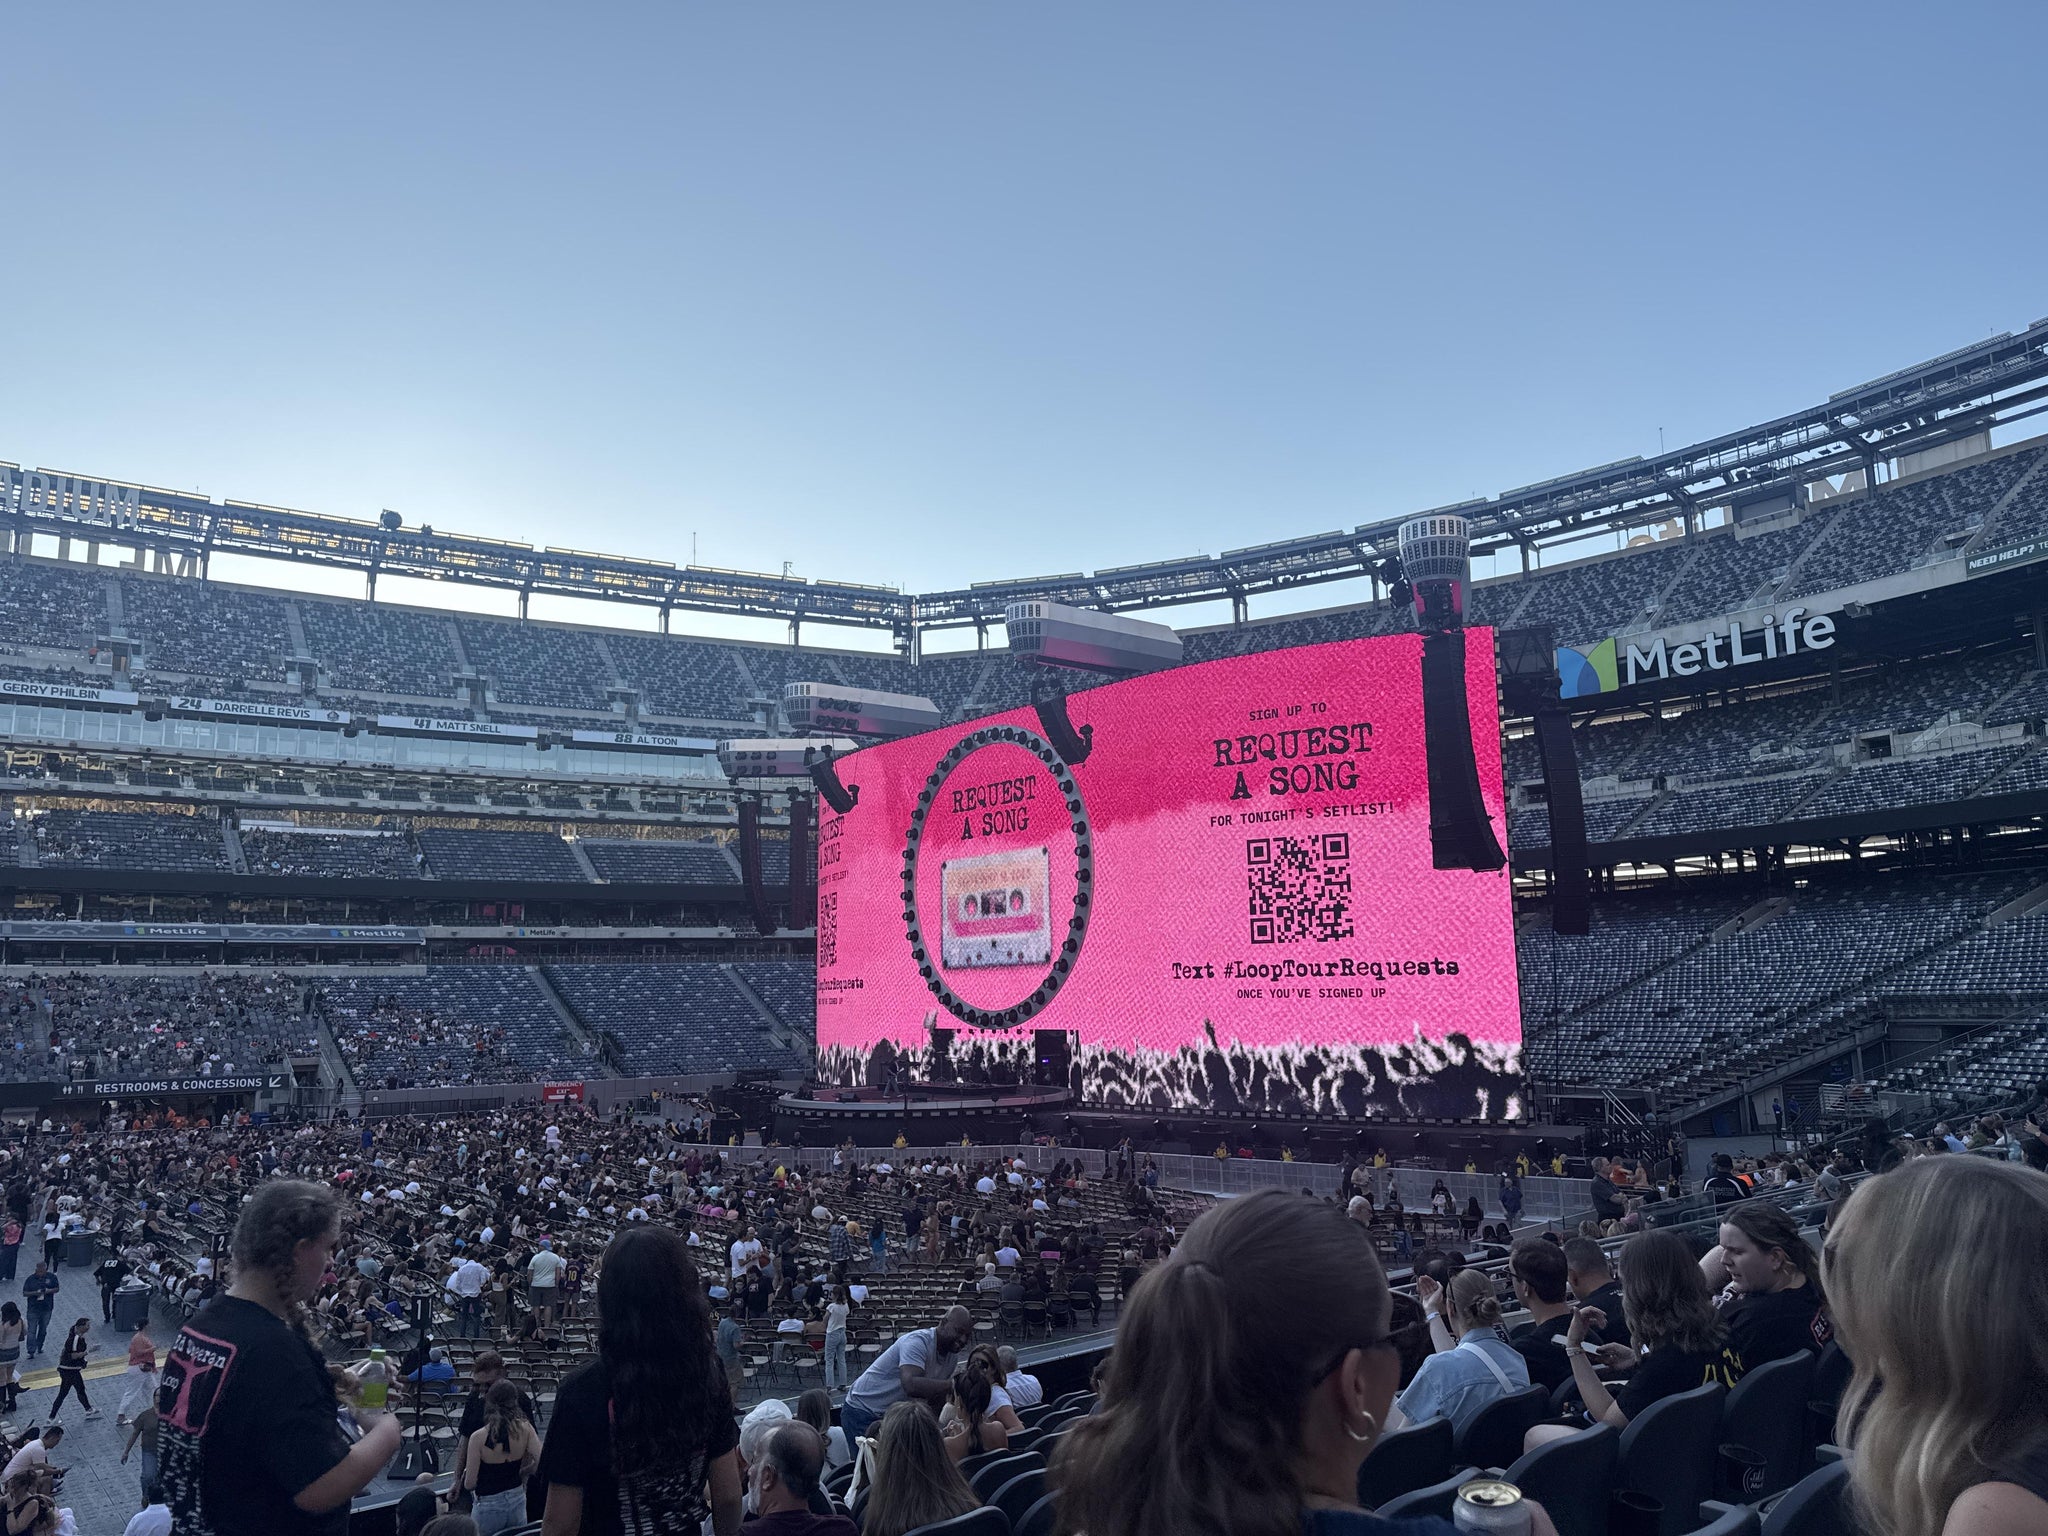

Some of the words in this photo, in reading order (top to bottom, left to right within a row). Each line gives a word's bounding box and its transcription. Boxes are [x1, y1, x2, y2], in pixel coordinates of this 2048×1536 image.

[1969, 554, 1997, 569] NEED
[1999, 544, 2035, 561] HELP?
[1626, 607, 1836, 685] MetLife
[2, 682, 48, 696] GERRY
[50, 687, 100, 700] PHILBIN
[177, 697, 202, 710] 24
[214, 702, 275, 716] DARRELLE
[276, 707, 311, 719] REVIS
[1249, 709, 1279, 721] SIGN
[1287, 706, 1302, 717] UP
[1311, 703, 1327, 714] TO
[414, 718, 432, 729] 41
[436, 721, 468, 732] MATT
[469, 723, 502, 734] SNELL
[614, 733, 633, 744] 88
[636, 735, 651, 745] AL
[652, 736, 678, 746] TOON
[1213, 723, 1373, 767] REQUEST
[1230, 771, 1252, 800] A
[1269, 761, 1360, 796] SONG
[952, 775, 1036, 813] REQUEST
[1210, 815, 1232, 827] FOR
[1240, 808, 1314, 824] TONIGHT'S
[1323, 802, 1394, 818] SETLIST!
[961, 817, 973, 840] A
[982, 809, 1030, 837] SONG
[149, 927, 207, 936] MetLife
[353, 929, 406, 939] MetLife
[530, 928, 556, 937] MetLife
[1172, 962, 1214, 979] Text
[1224, 957, 1460, 981] #LoopTourRequests
[1237, 988, 1263, 999] ONCE
[1269, 988, 1311, 999] YOU'VE
[1319, 987, 1363, 999] SIGNED
[1371, 987, 1386, 999] UP
[94, 1081, 169, 1094] RESTROOMS
[171, 1079, 180, 1091] &
[182, 1077, 263, 1091] CONCESSIONS
[544, 1080, 583, 1088] EMERGENCY
[218, 1235, 225, 1252] 2
[568, 1270, 577, 1282] 10
[405, 1453, 413, 1469] 1
